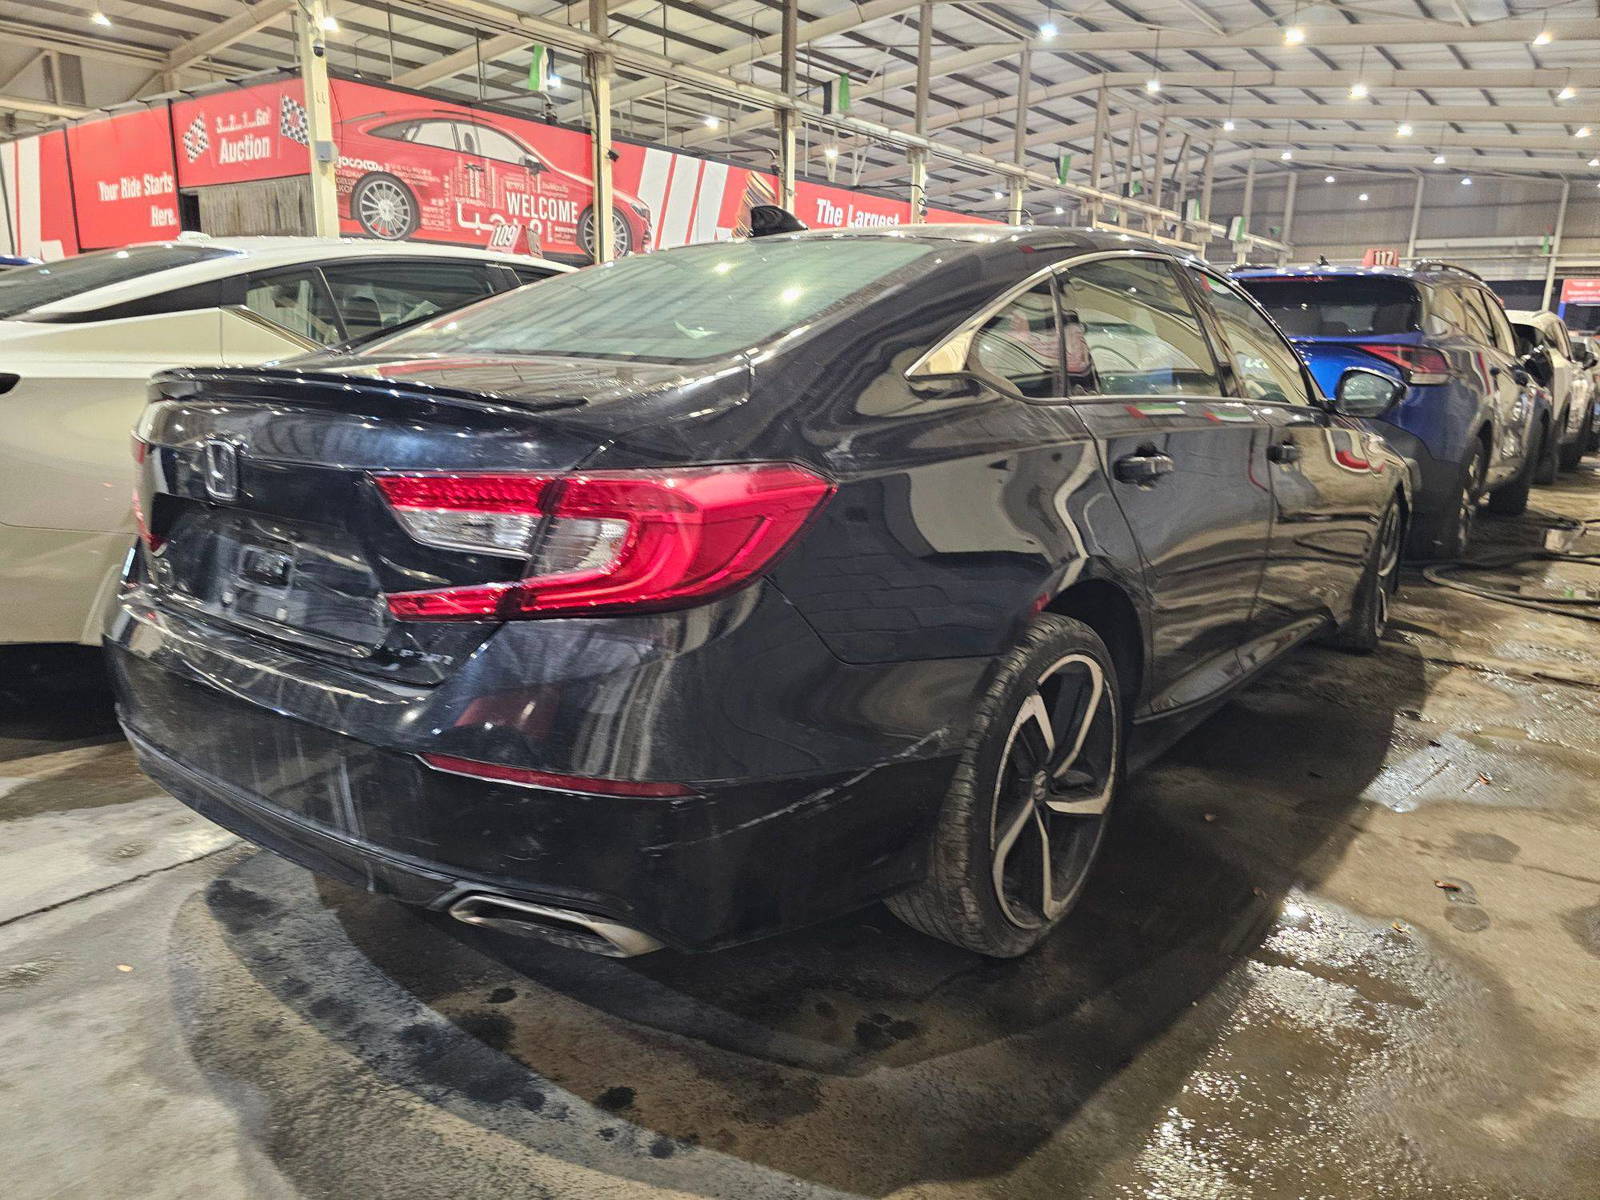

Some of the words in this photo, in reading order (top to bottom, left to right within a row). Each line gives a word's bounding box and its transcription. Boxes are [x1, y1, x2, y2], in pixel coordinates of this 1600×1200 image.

[219, 134, 271, 164] Auction
[98, 180, 119, 201] Your
[120, 176, 142, 200] Ride
[143, 172, 174, 196] Starts
[151, 204, 177, 227] Here.
[506, 192, 579, 224] WELCOME
[816, 198, 843, 226] The
[492, 223, 518, 247] 109
[1374, 251, 1394, 265] 117
